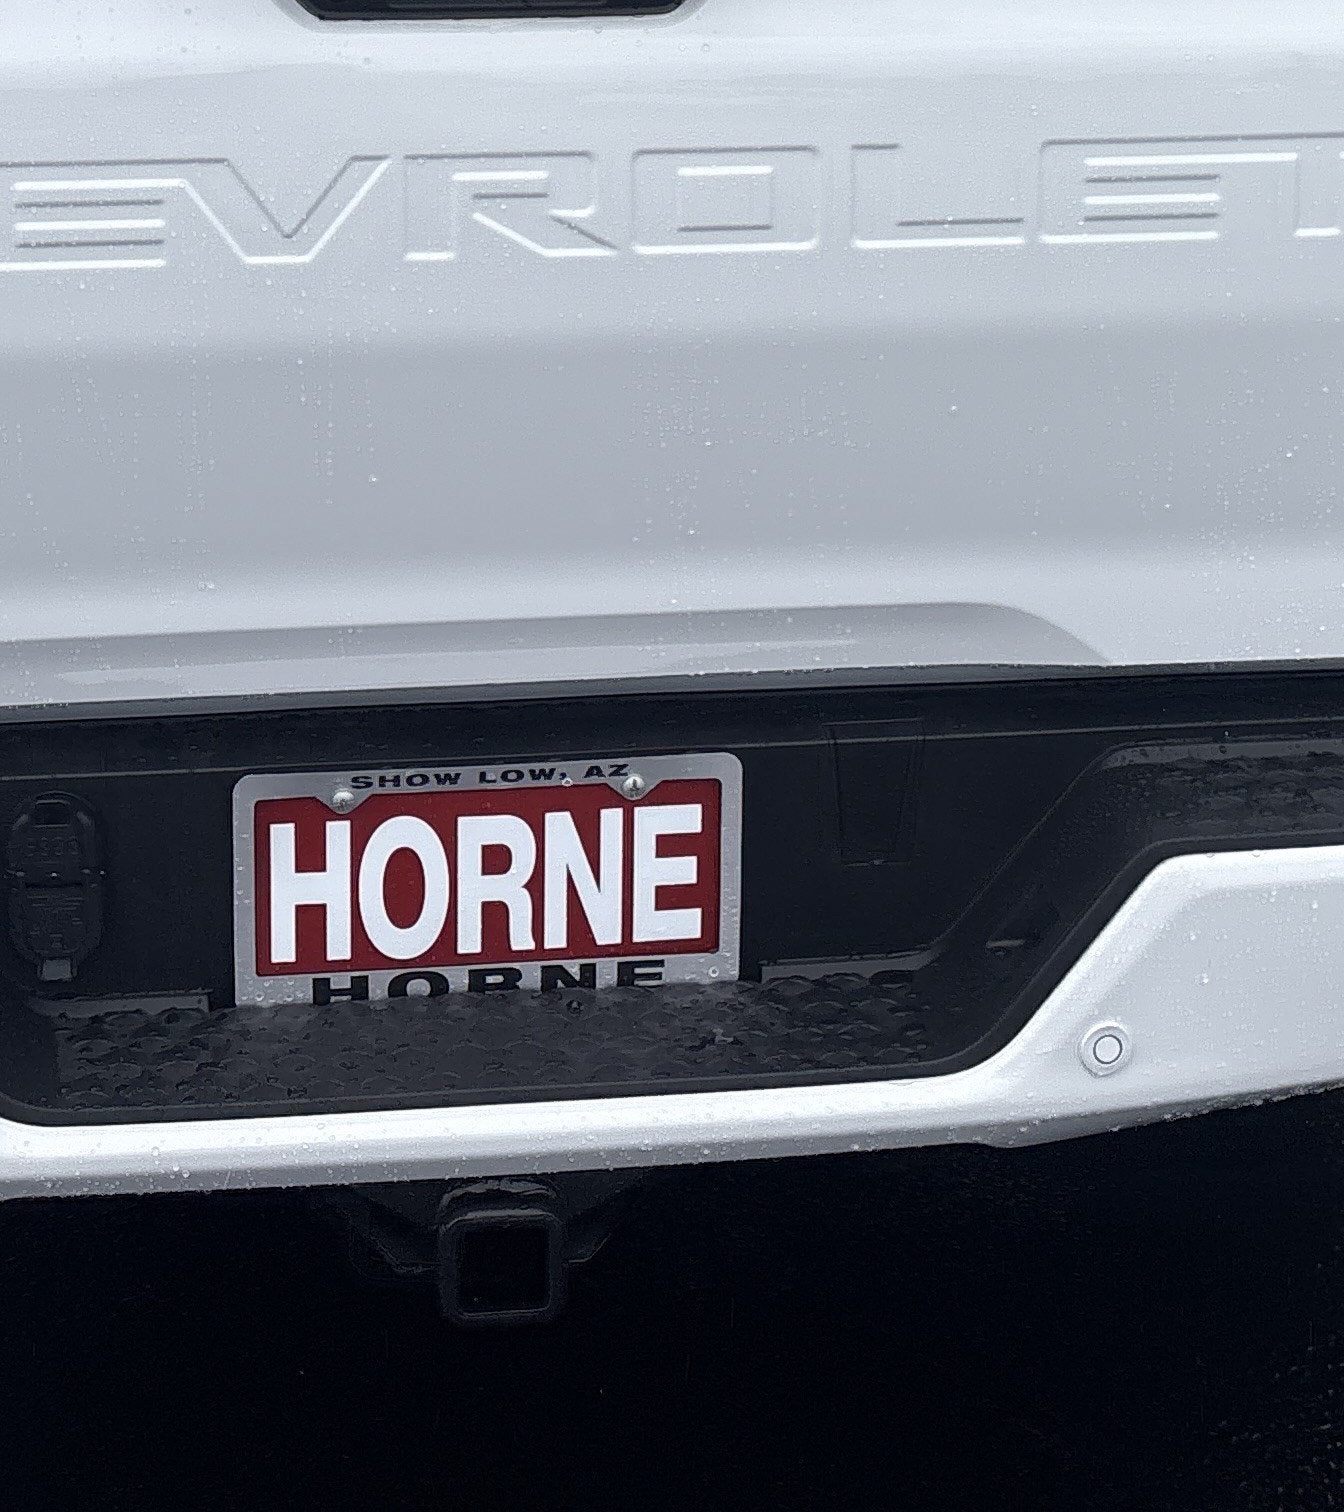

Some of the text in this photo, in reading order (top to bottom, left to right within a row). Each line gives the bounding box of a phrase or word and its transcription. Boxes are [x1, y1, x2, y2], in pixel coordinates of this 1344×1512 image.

[351, 763, 630, 789] SHOW LOW, AZ
[269, 803, 703, 963] HORNE
[312, 960, 665, 1005] HORNE
